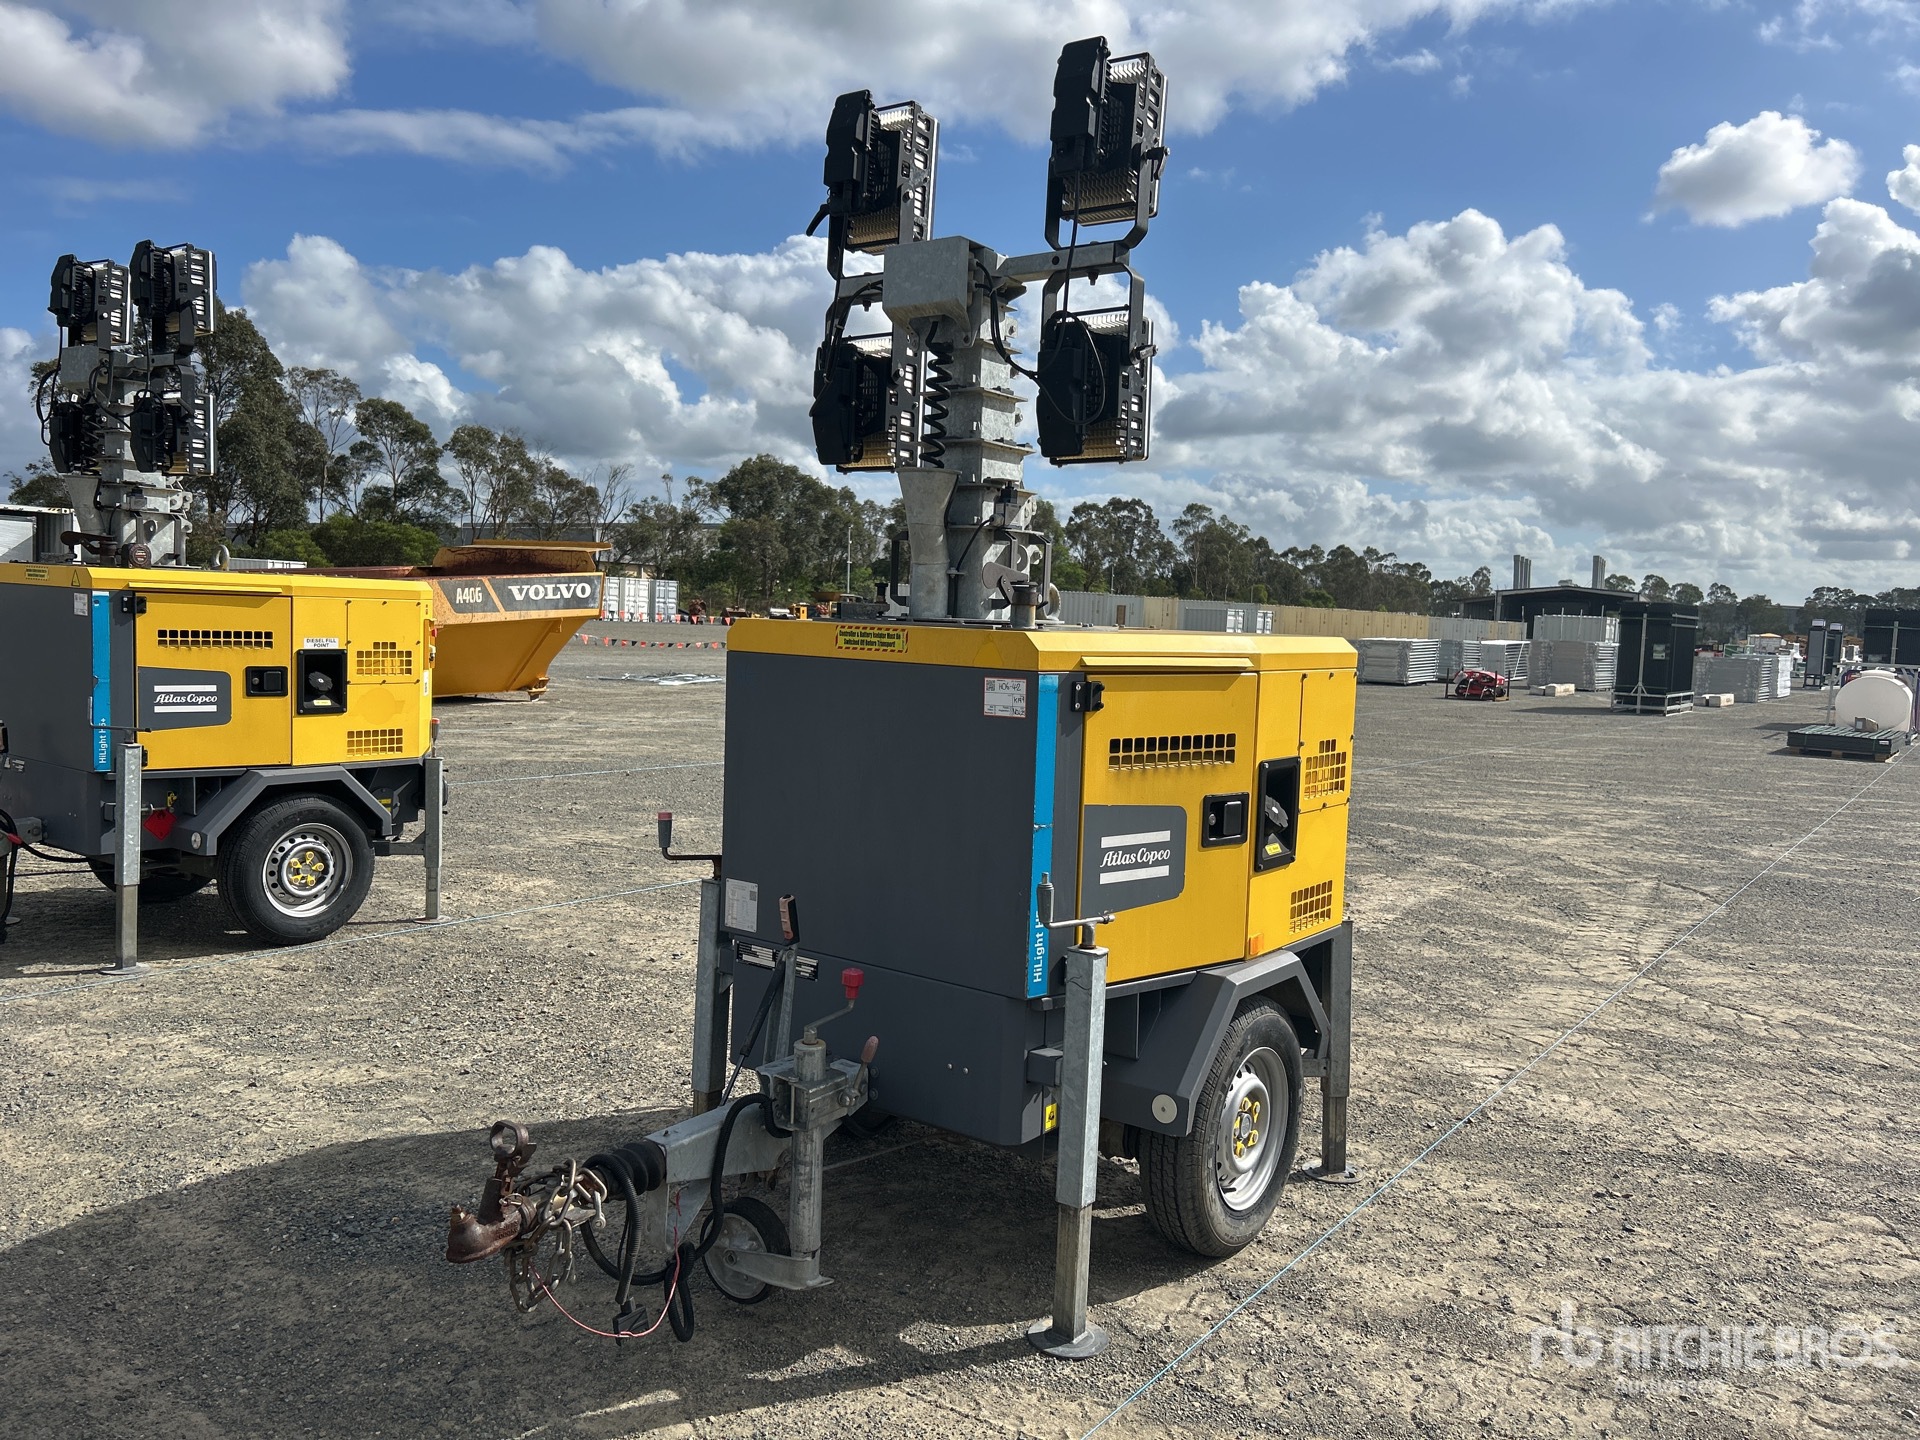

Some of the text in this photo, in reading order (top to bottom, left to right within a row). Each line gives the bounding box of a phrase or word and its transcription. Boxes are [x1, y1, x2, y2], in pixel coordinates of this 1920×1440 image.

[456, 583, 592, 603] A40G VOLVO
[154, 693, 218, 705] Atlas Copco
[99, 735, 108, 764] HiLight
[1099, 847, 1171, 868] Atlas Copco
[1033, 931, 1045, 983] HiLight
